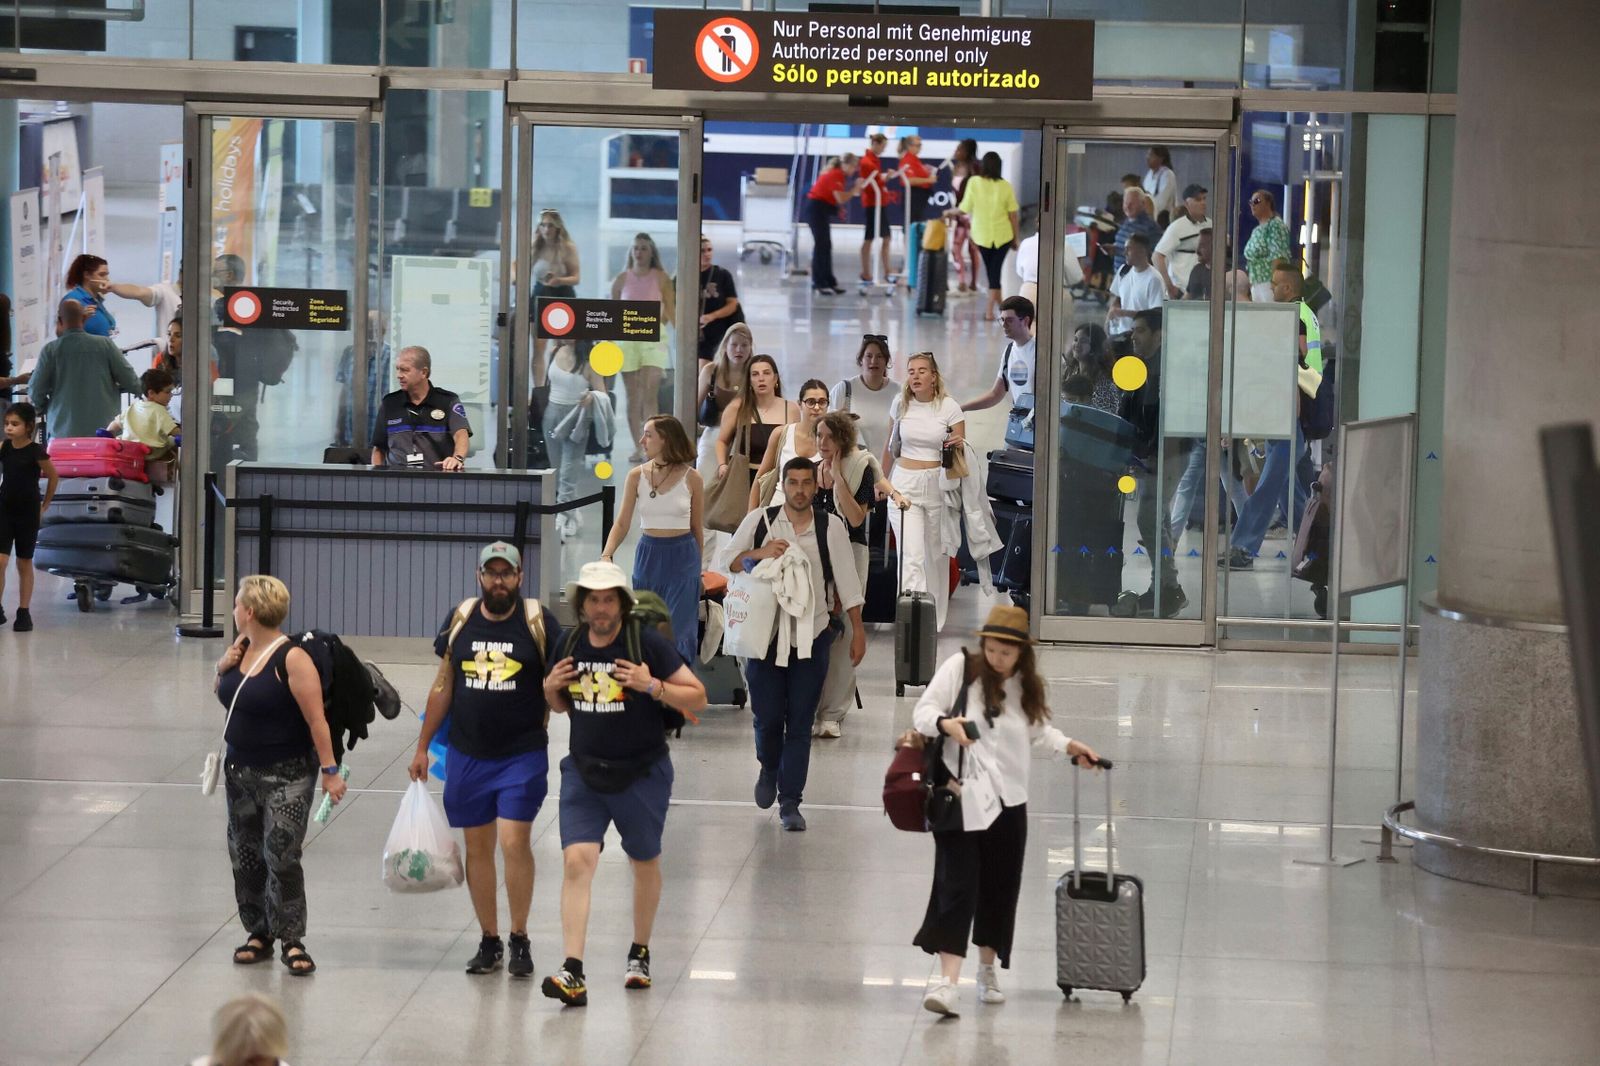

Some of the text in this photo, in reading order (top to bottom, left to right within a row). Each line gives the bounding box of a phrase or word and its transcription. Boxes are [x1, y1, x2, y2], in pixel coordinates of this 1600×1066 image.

[773, 20, 1032, 46] Nur Personal mit Genehmigung
[772, 41, 988, 67] Authorized personnel only
[772, 62, 1040, 89] Sólo personal autorizado
[215, 135, 243, 212] holidays
[471, 641, 514, 654] SIN DOLOR
[488, 680, 517, 691] GLORIA
[595, 702, 625, 713] GLORIA
